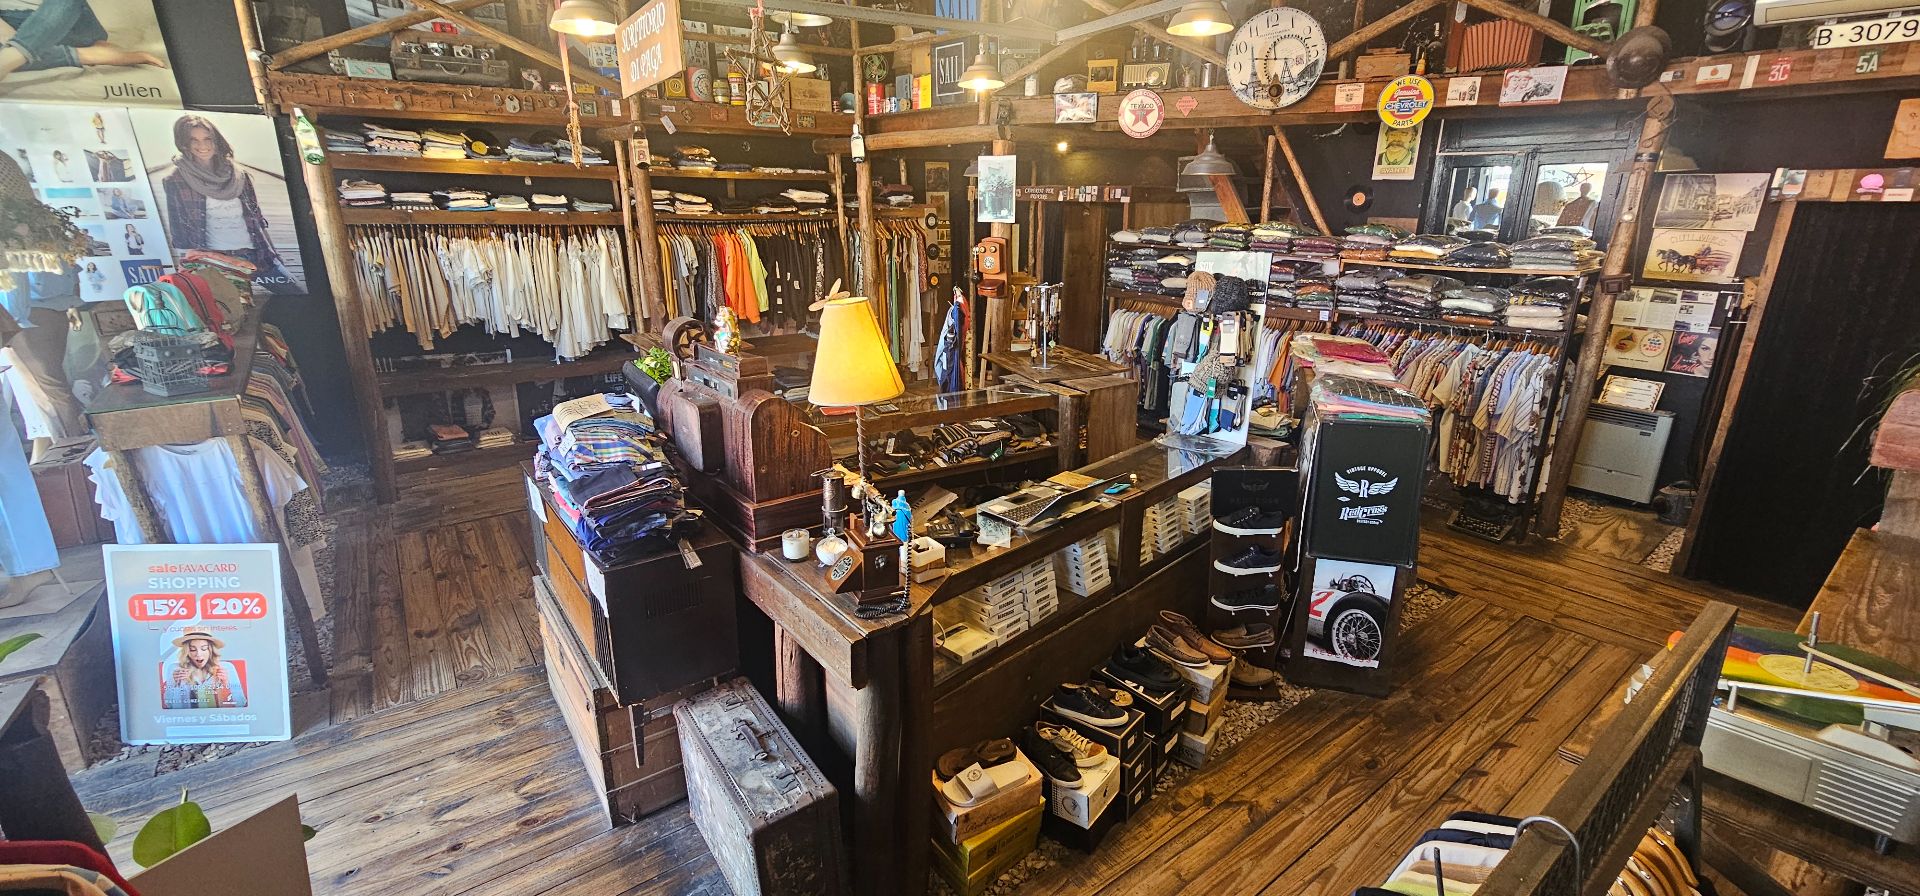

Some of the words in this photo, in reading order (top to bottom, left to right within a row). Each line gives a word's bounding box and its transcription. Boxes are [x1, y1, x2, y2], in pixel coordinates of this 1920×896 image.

[1266, 13, 1279, 28] 12
[621, 2, 666, 53] SCRITTORIO
[1235, 41, 1248, 55] 10
[1855, 55, 1879, 74] 5A
[1768, 63, 1792, 82] 3C
[1395, 78, 1406, 87] WE
[1409, 77, 1422, 87] USE
[1383, 100, 1429, 110] CHEVROLET
[1392, 118, 1414, 127] PARTS
[251, 276, 297, 284] ANCA
[374, 357, 397, 373] AIL
[604, 373, 623, 383] LIFE
[1358, 479, 1369, 498] R
[148, 563, 177, 573] sale
[178, 563, 237, 573] FAVACARD
[148, 576, 241, 589] SHOPPING
[143, 598, 188, 616] 15%
[210, 597, 262, 615] 20%
[154, 715, 197, 724] Viernes
[209, 712, 257, 722] Sábados
